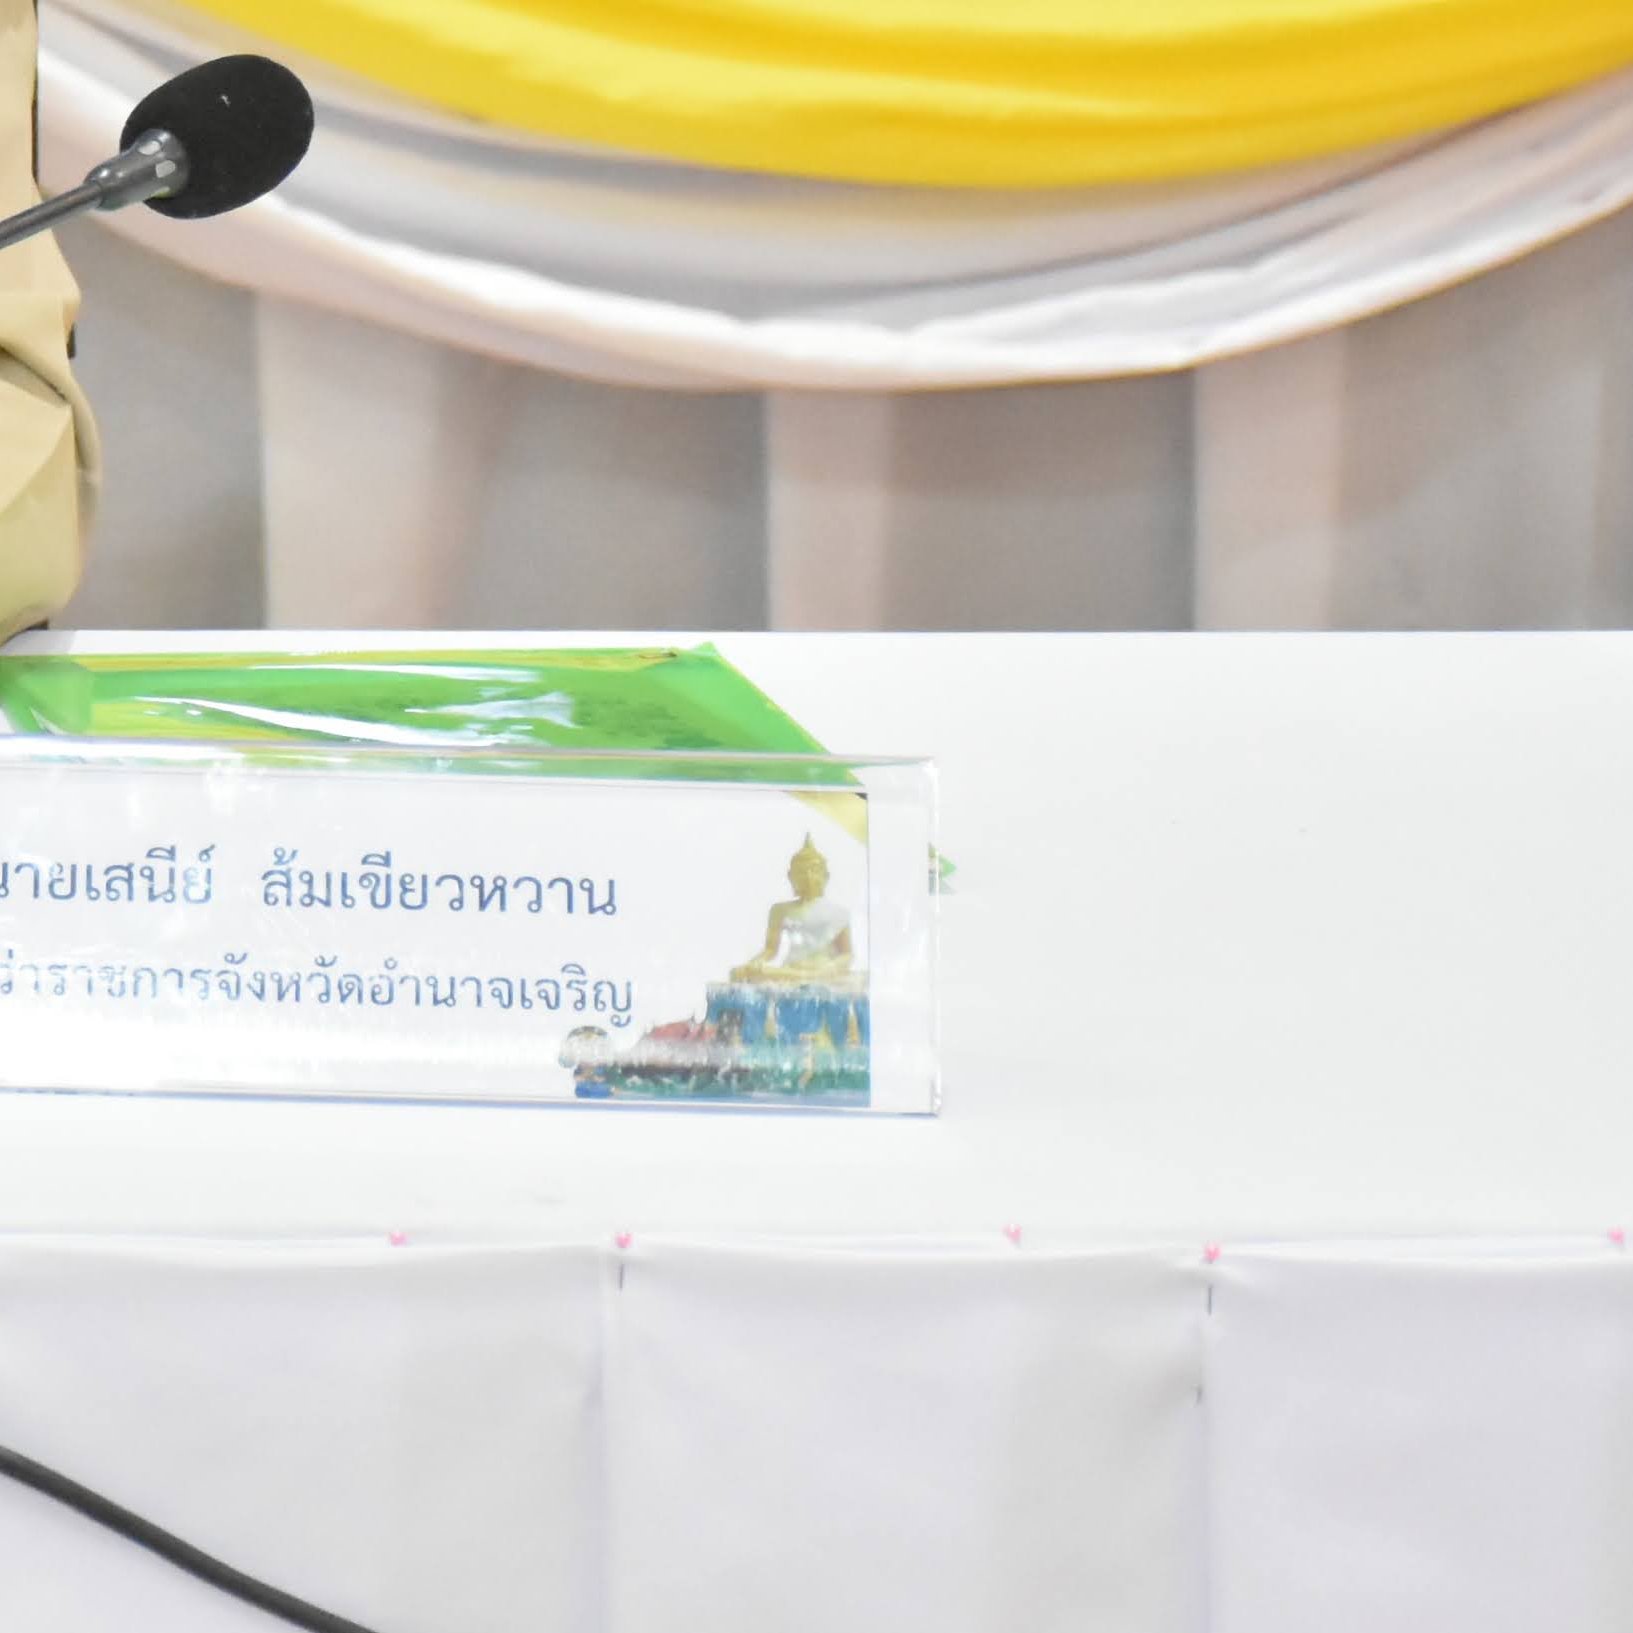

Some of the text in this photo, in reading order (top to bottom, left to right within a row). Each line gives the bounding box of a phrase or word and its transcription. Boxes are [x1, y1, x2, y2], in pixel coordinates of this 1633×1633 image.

[261, 847, 617, 916] ส้มเขียวหวาน
